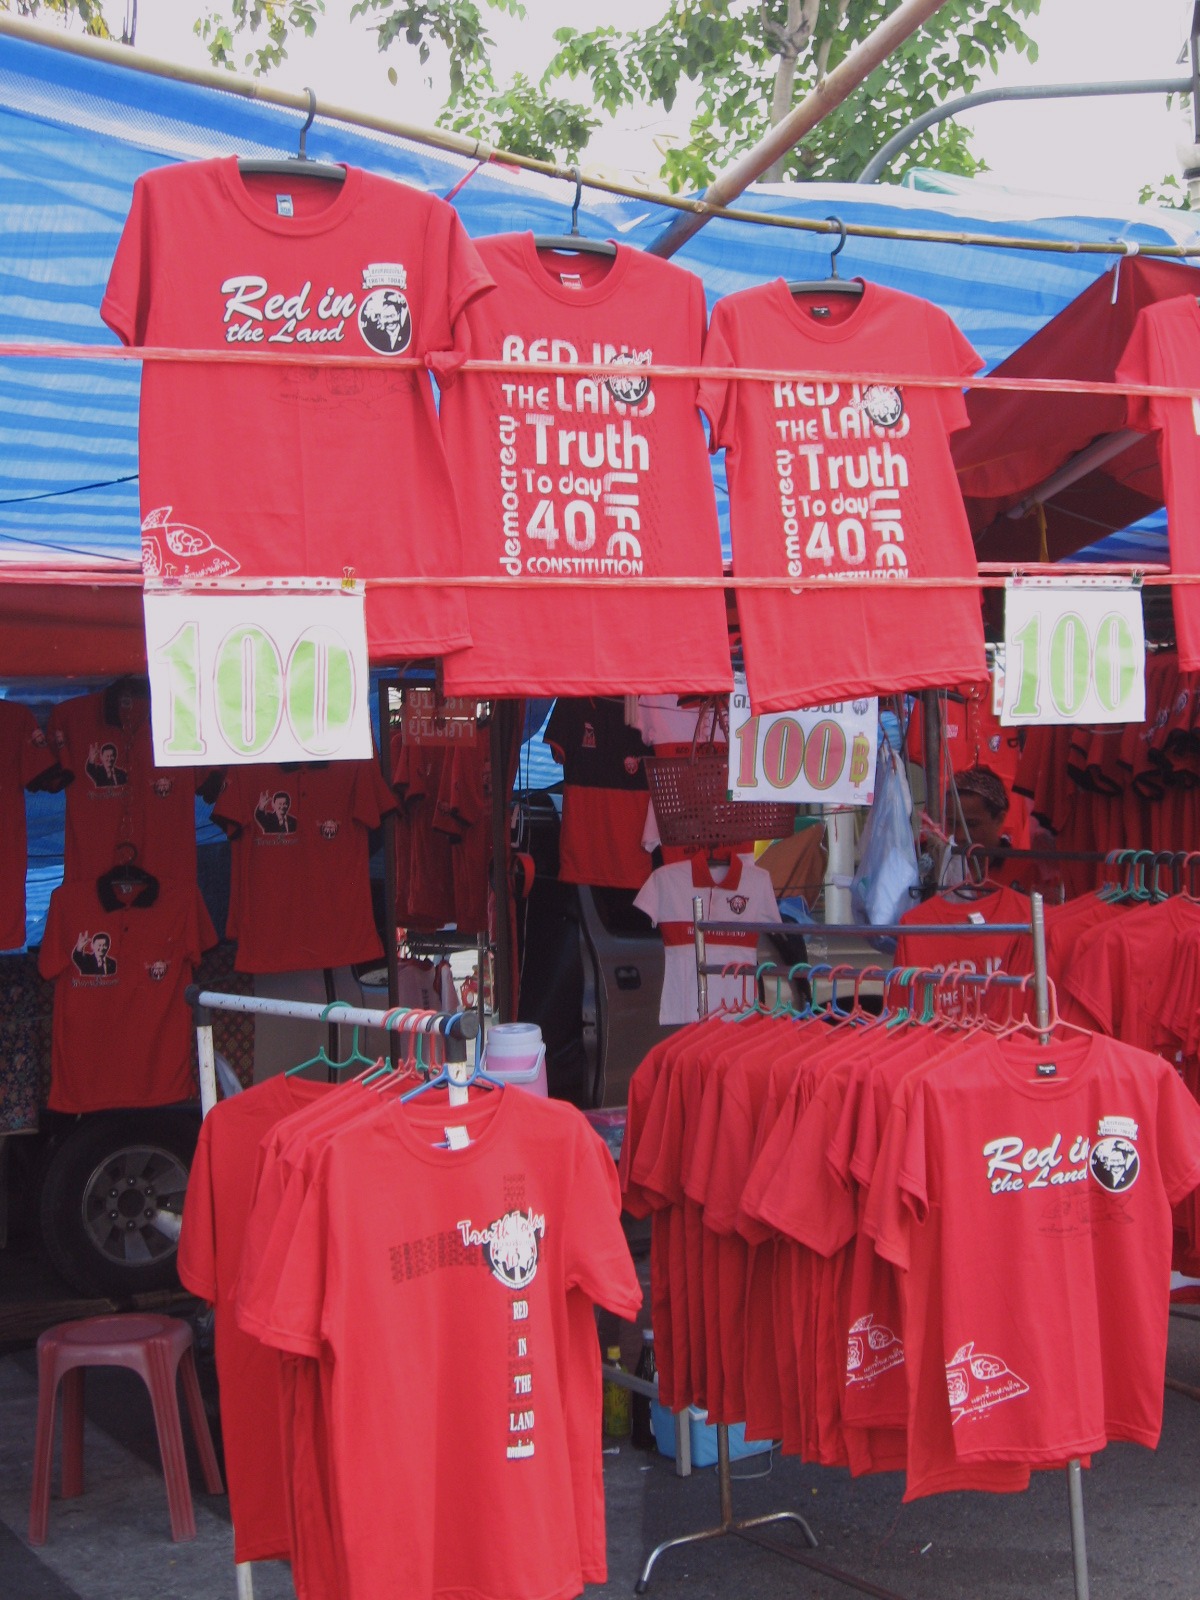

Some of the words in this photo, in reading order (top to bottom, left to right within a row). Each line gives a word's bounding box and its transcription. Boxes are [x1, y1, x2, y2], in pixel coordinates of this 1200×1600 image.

[220, 275, 311, 322] Red
[317, 287, 356, 319] in
[225, 319, 264, 342] the
[268, 319, 344, 342] Land
[502, 334, 579, 365] RED
[501, 383, 549, 411] THE
[525, 412, 650, 471] Truth
[775, 419, 819, 442] THE
[798, 441, 909, 491] Truth
[525, 499, 596, 552] 40
[603, 471, 642, 558] LIFE
[868, 489, 908, 568] LIFE
[805, 517, 867, 567] 40
[526, 556, 644, 576] CONSTITUTION
[1010, 610, 1137, 718] 100
[156, 620, 357, 757] 100
[735, 716, 847, 791] 100
[983, 1132, 1063, 1179] Red
[990, 1173, 1024, 1194] the
[1028, 1162, 1088, 1189] Land
[457, 1213, 510, 1247] Truth
[512, 1300, 529, 1321] RED
[517, 1337, 528, 1357] IN
[513, 1375, 532, 1394] THE
[509, 1410, 535, 1432] LAND
